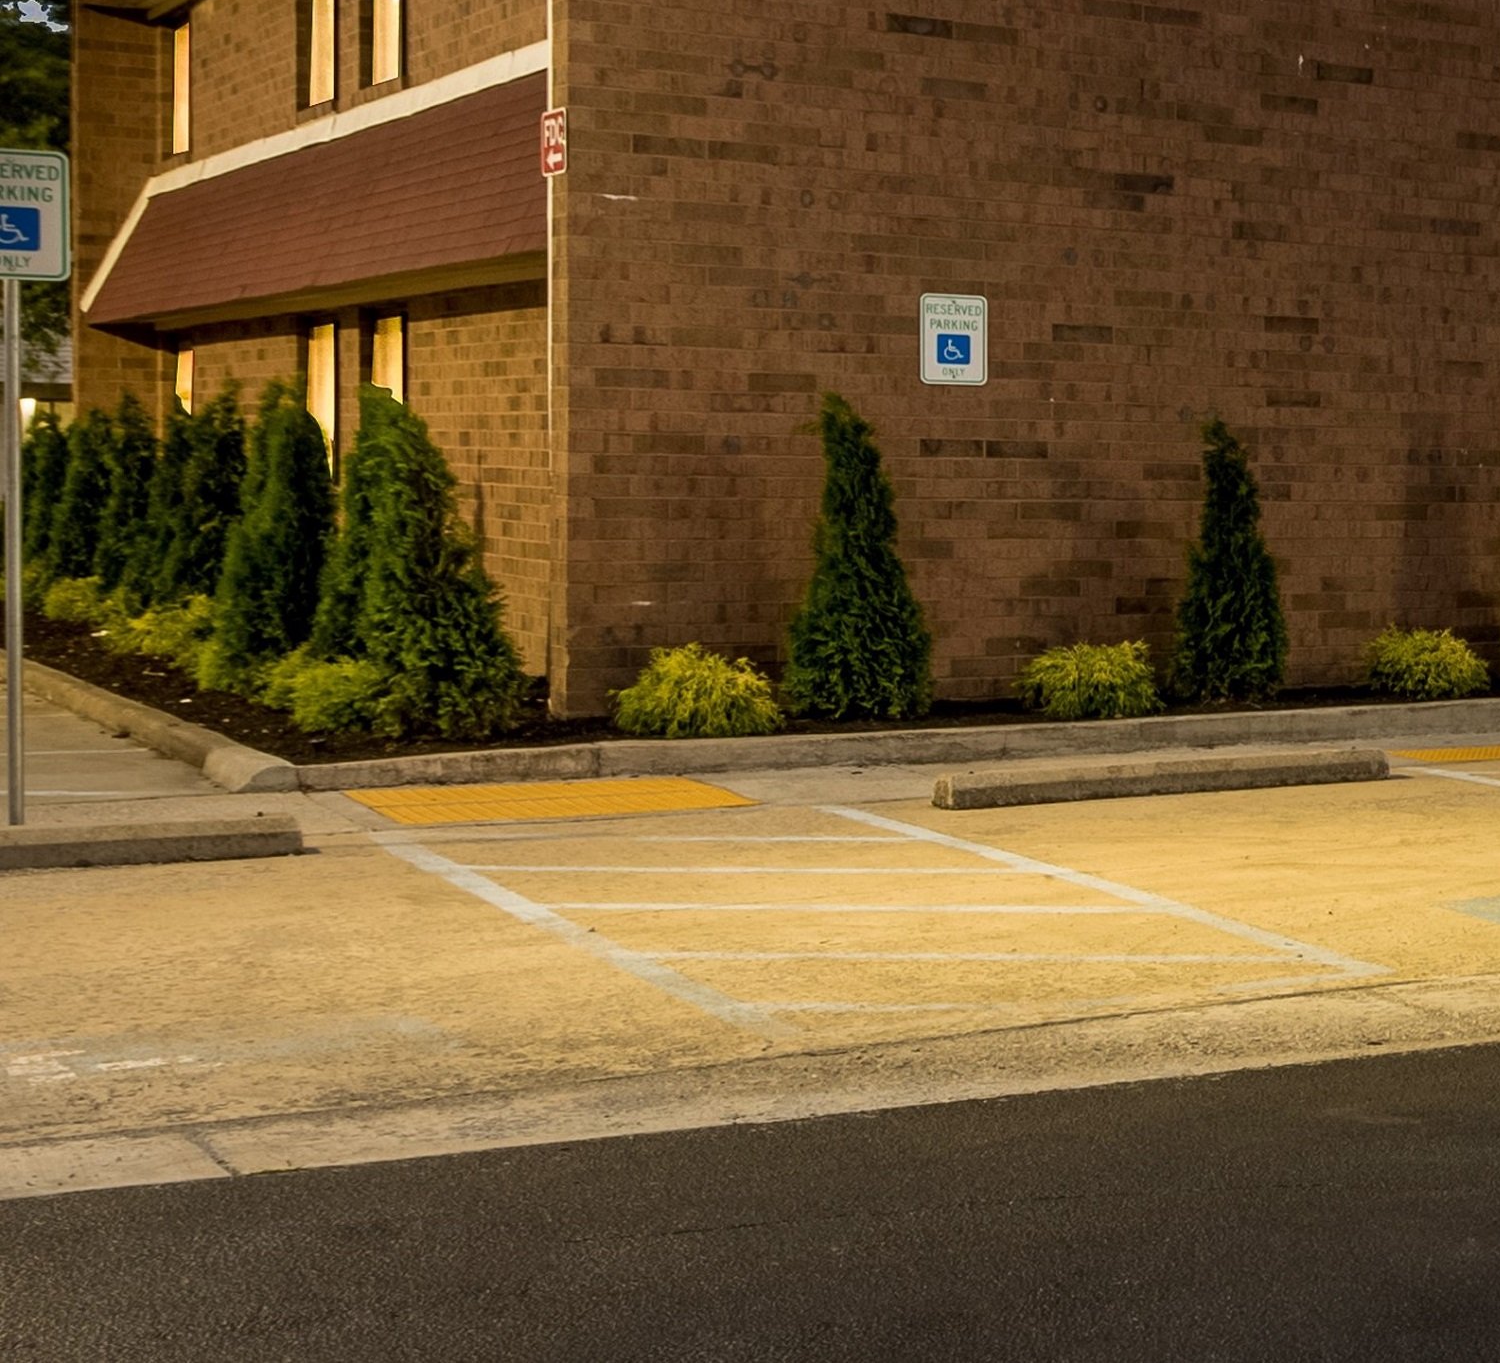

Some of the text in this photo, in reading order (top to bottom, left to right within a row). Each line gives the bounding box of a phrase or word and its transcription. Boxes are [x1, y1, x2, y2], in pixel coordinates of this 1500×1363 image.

[544, 115, 564, 148] FDC
[0, 162, 59, 181] ERVED
[0, 255, 32, 268] NLY
[926, 303, 982, 317] RESERVED
[929, 318, 978, 331] PARKING
[941, 367, 966, 377] ONLY
